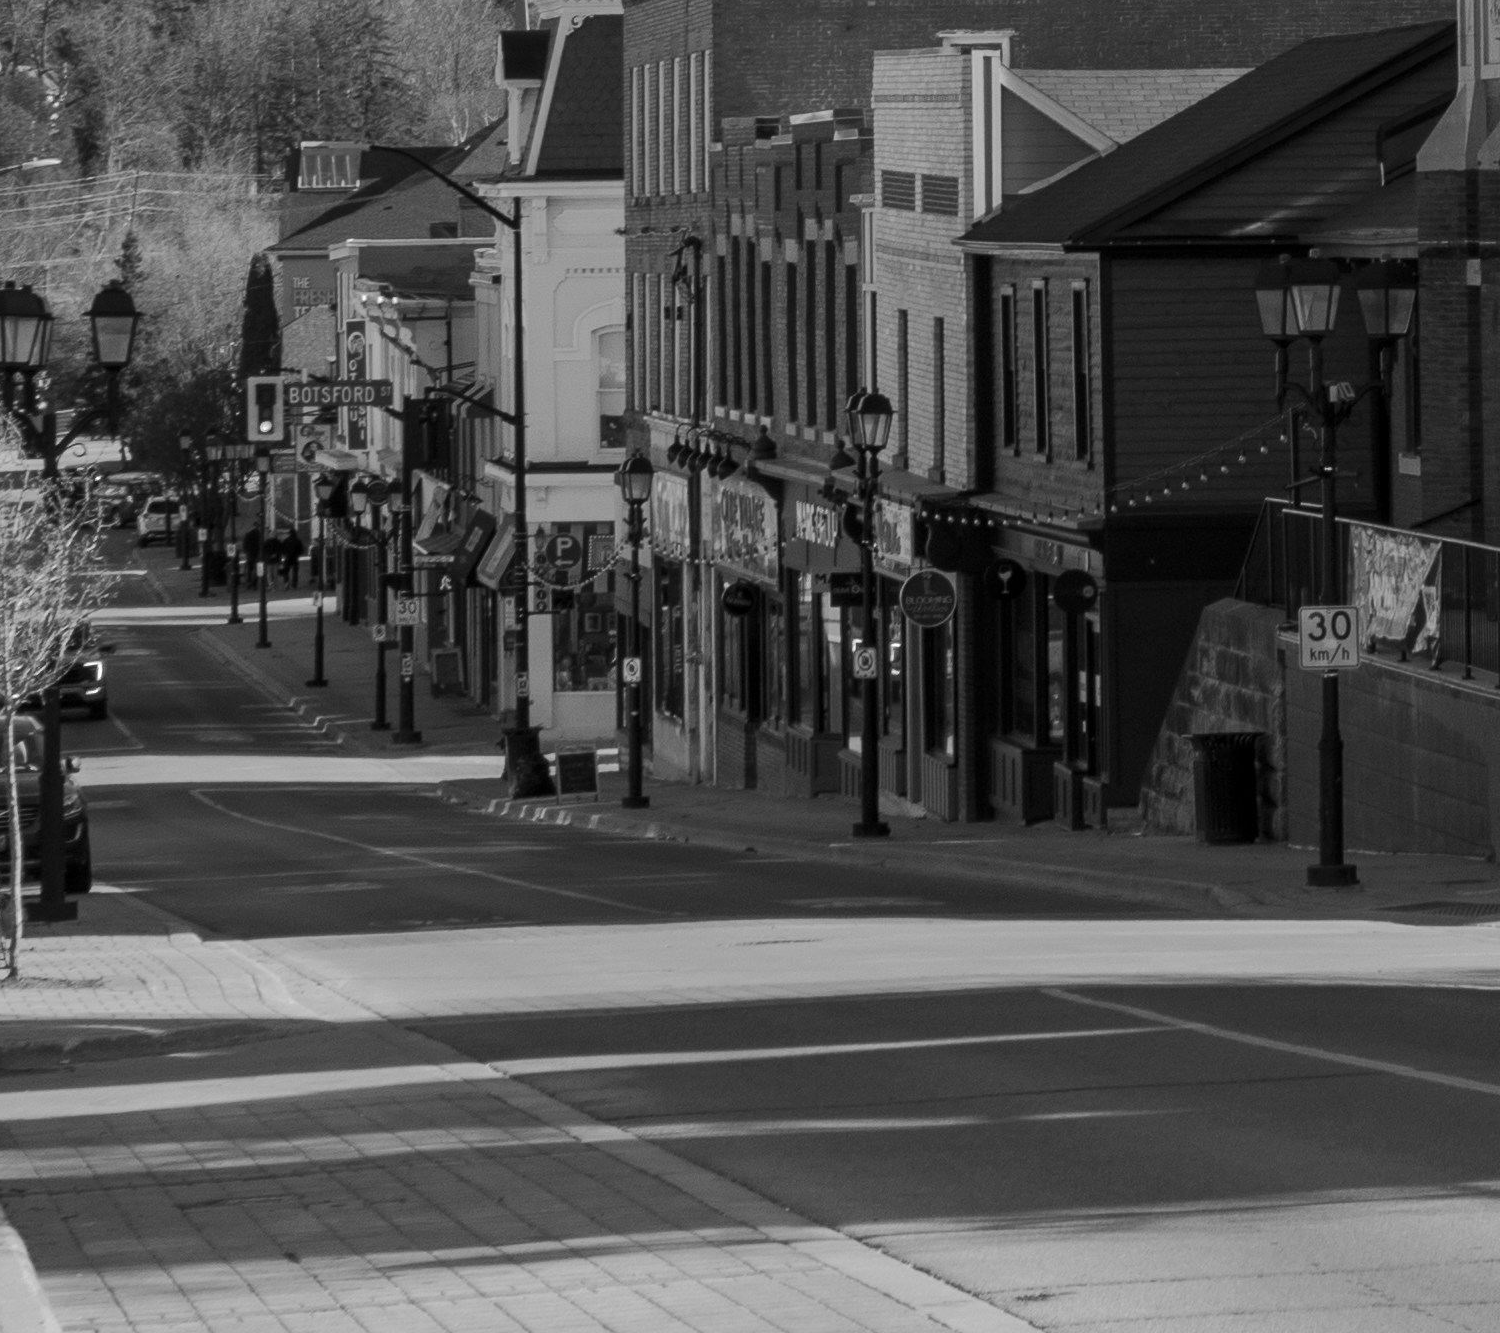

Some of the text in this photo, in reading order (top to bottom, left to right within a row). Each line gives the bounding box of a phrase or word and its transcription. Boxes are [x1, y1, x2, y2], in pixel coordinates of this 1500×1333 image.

[293, 277, 311, 289] THE
[294, 290, 336, 304] FRESH
[288, 386, 392, 404] BOTSFORD ST
[556, 537, 573, 557] P
[398, 601, 417, 614] 30
[1307, 611, 1352, 641] 30
[1310, 643, 1350, 663] km/h
